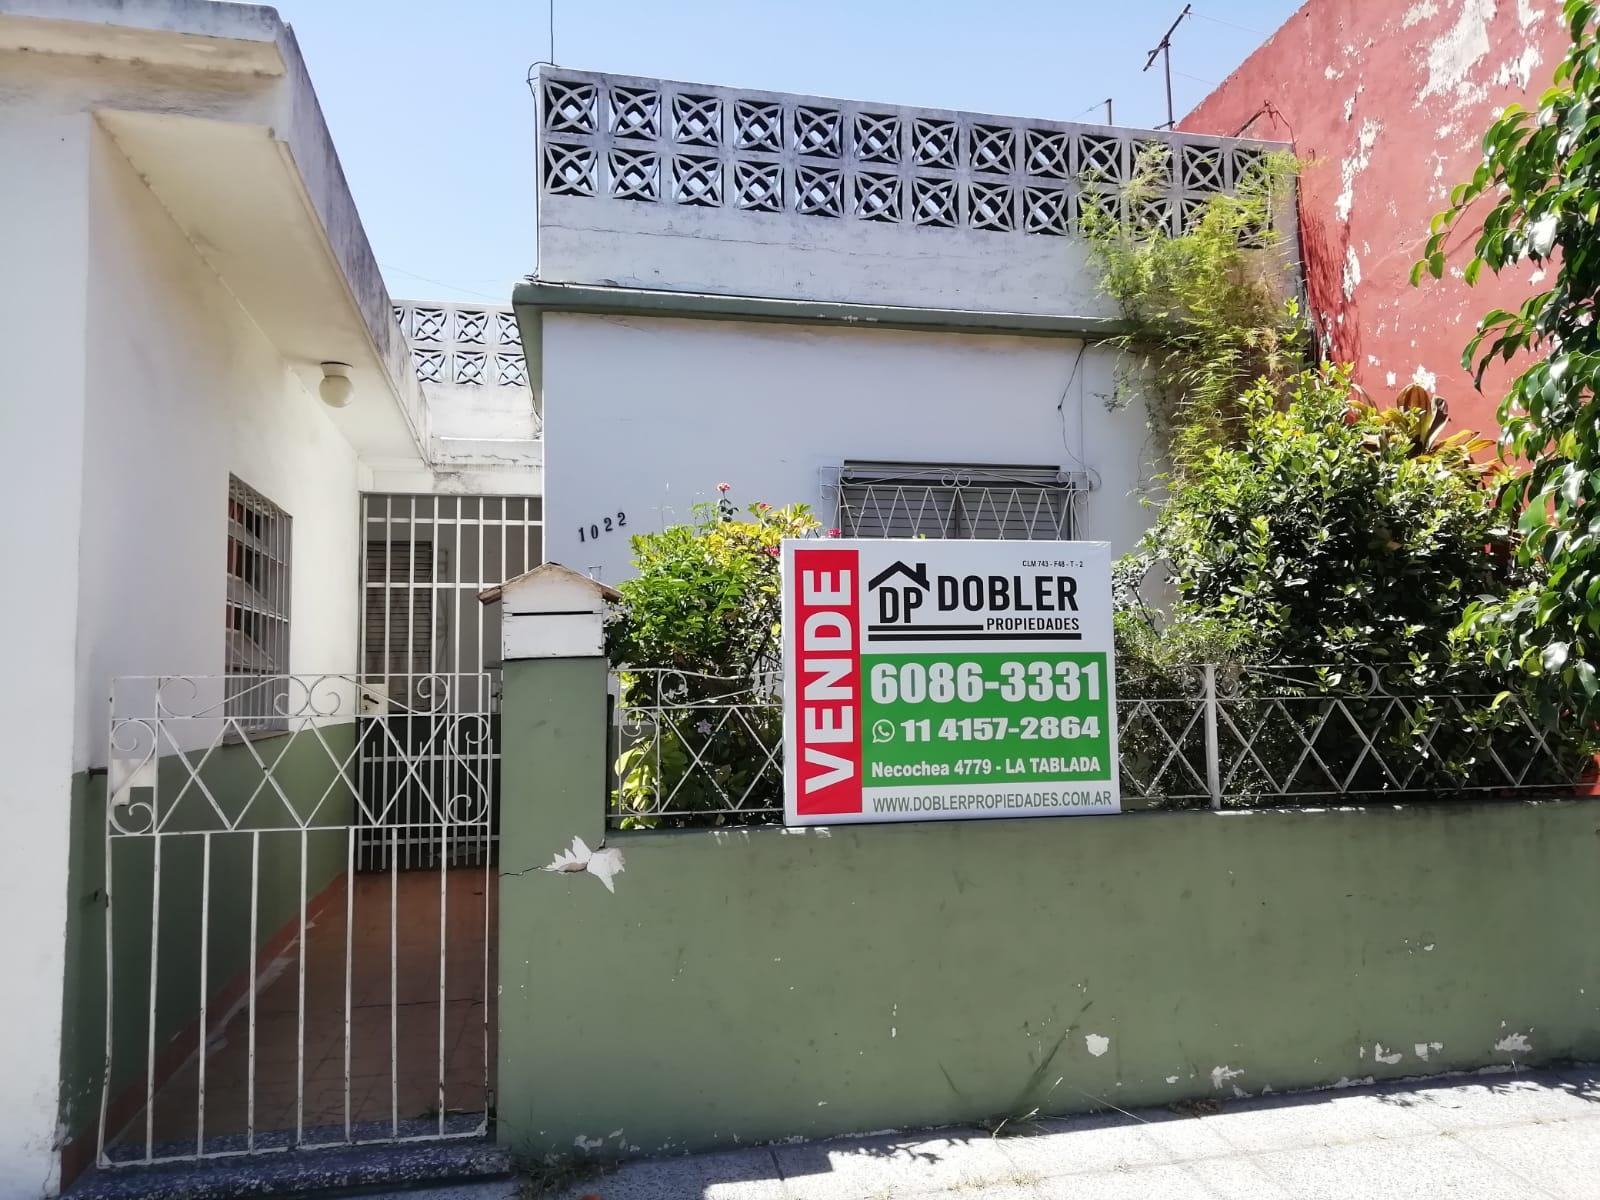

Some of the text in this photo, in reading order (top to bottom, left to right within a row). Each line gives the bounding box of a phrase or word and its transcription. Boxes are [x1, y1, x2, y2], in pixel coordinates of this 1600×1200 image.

[578, 511, 627, 542] 1022
[879, 586, 923, 624] DP
[937, 575, 1080, 612] DOBLER
[986, 617, 1080, 631] PROPIEDADES
[803, 570, 855, 794] VENDE
[870, 661, 1100, 704] 6086-3331
[901, 716, 1100, 742] 11 4157-2864
[872, 761, 950, 778] Necochea
[954, 759, 991, 775] 4779
[1005, 758, 1026, 774] LA
[1029, 756, 1101, 773] TABLADA
[873, 791, 1112, 813] WWW.DOBLERPROPIEDADES.COM.AR
